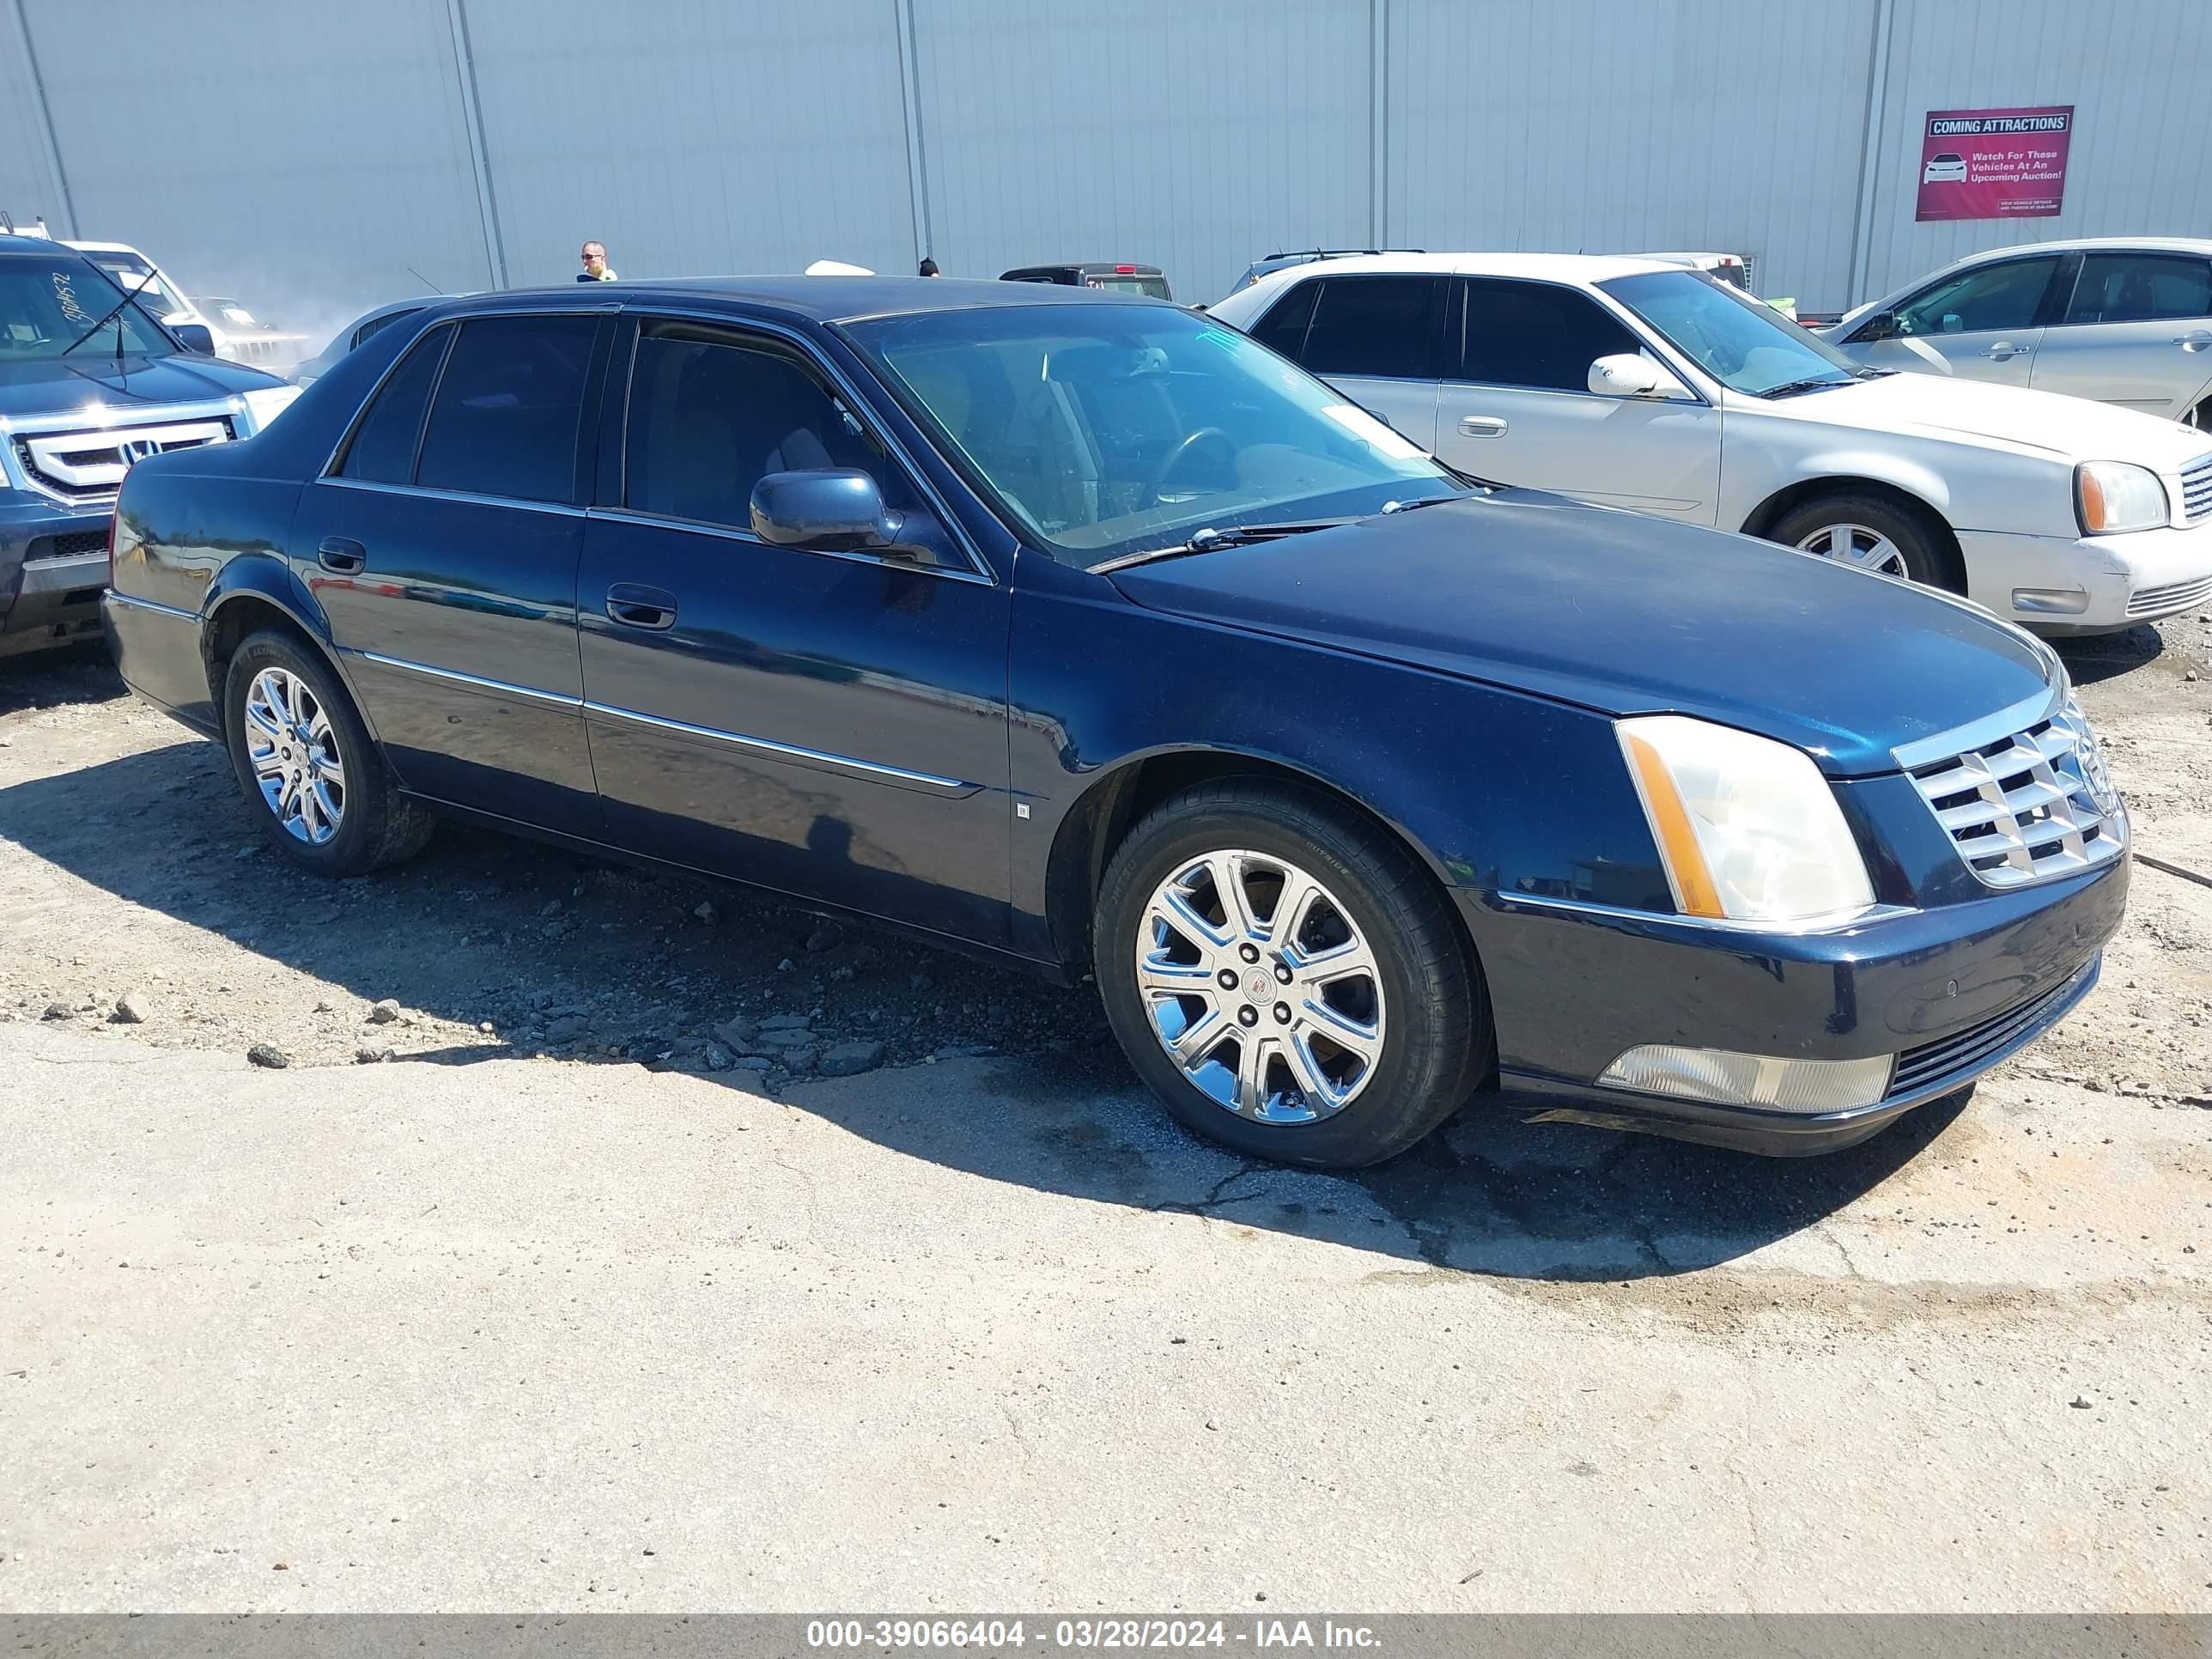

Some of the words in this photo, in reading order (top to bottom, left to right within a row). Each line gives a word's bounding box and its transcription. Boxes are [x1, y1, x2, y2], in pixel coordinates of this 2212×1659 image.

[1934, 119, 1981, 134] COMING
[1983, 116, 2064, 132] ATTRACTIONS
[1972, 152, 2004, 161] Watch
[2027, 150, 2057, 159] These
[1972, 162, 2014, 172] Vehicles
[1971, 173, 2020, 183] Upcoming
[2021, 171, 2062, 180] Auction!
